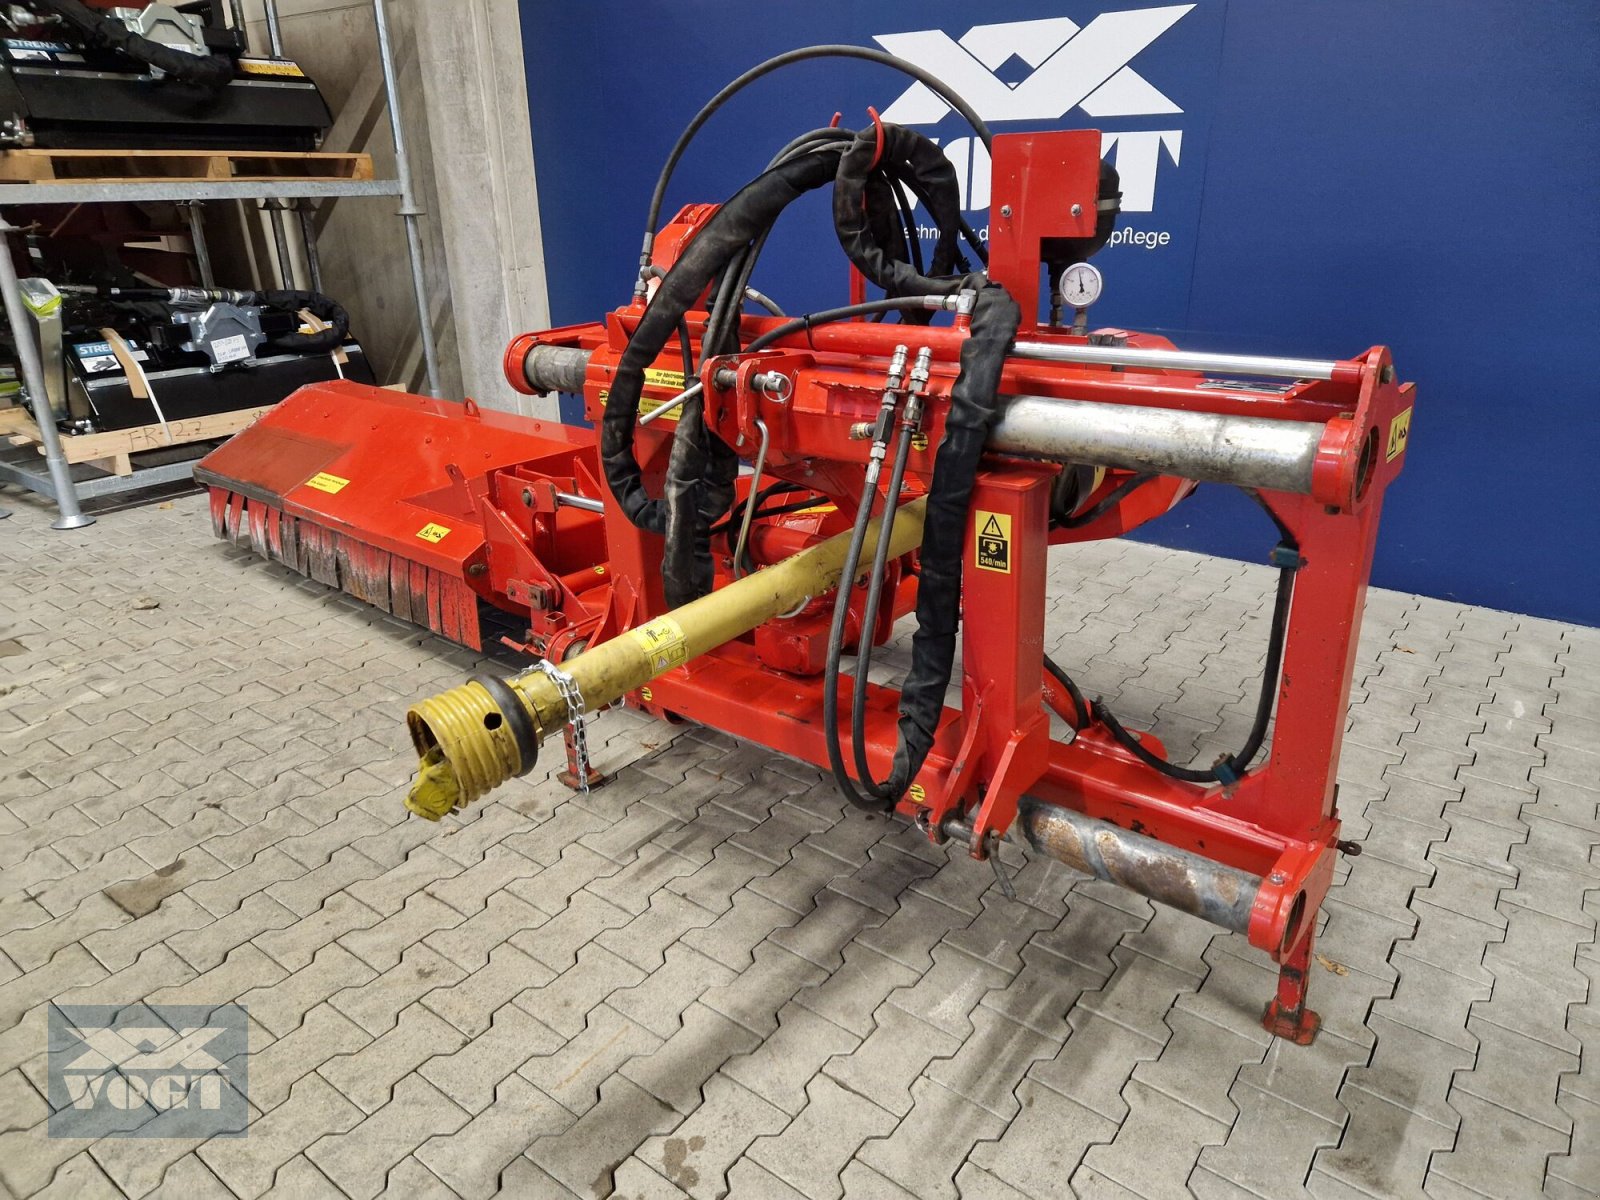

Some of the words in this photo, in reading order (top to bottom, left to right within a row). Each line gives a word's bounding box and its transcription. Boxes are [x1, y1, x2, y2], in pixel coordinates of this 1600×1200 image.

[8, 39, 60, 50] STRENX
[1106, 227, 1170, 249] pflege
[981, 557, 1006, 567] 540/min
